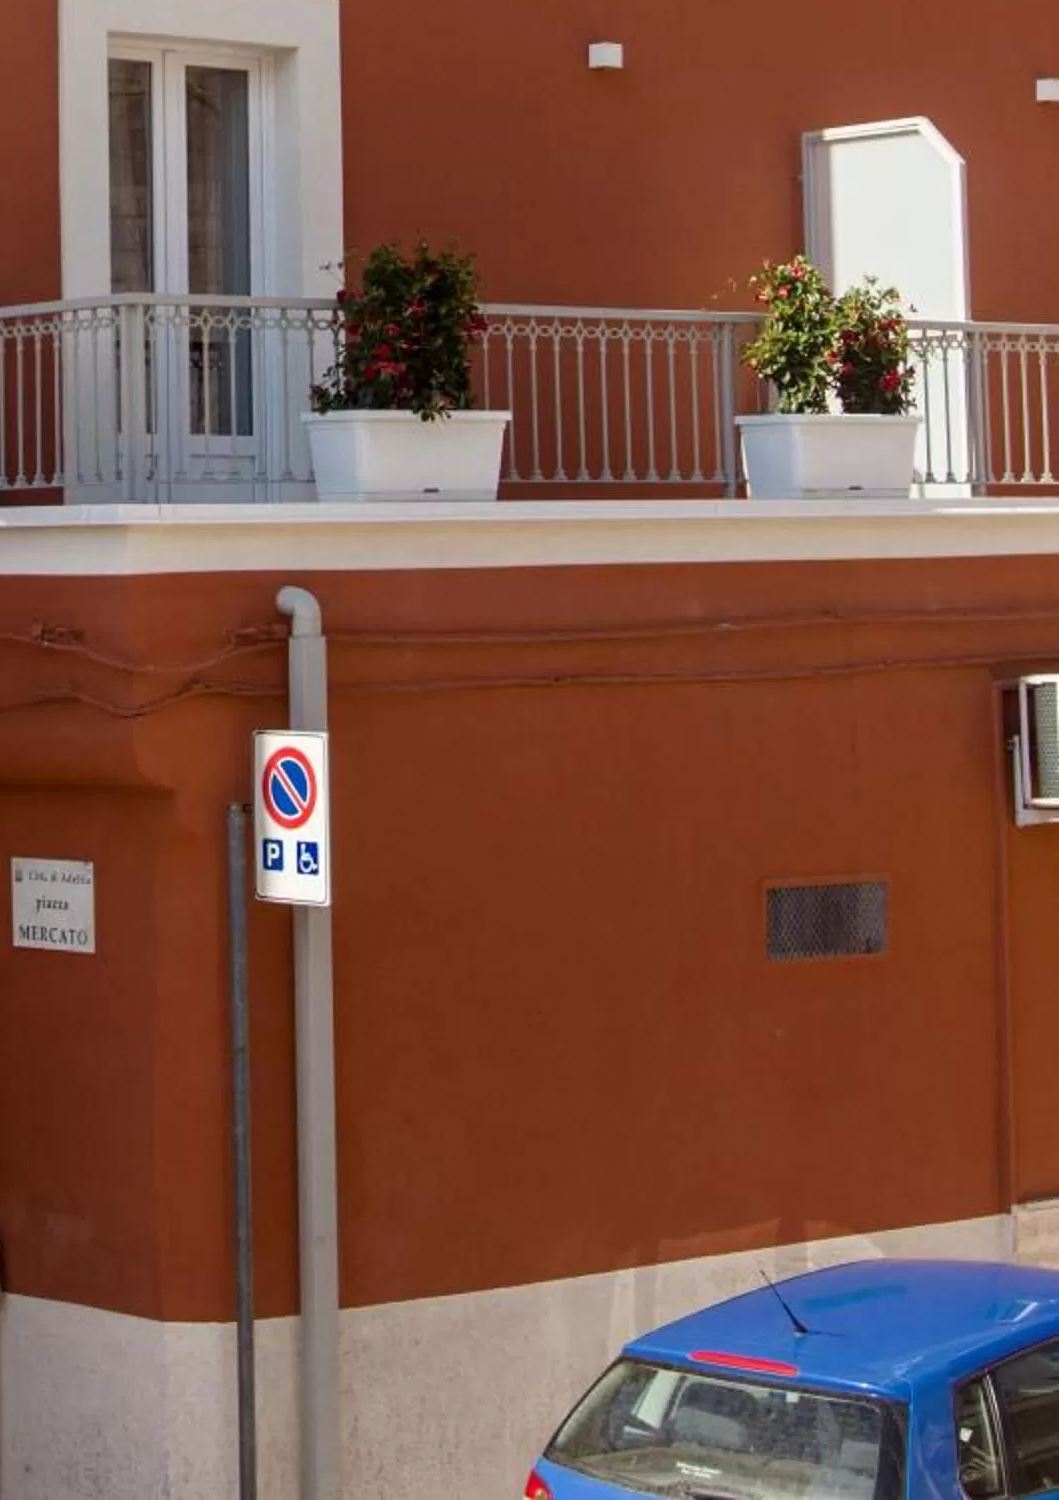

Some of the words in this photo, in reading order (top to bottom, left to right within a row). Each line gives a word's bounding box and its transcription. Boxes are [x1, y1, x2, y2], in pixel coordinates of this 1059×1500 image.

[266, 842, 281, 867] P
[36, 895, 69, 913] piazza
[18, 925, 88, 946] MERCATO
